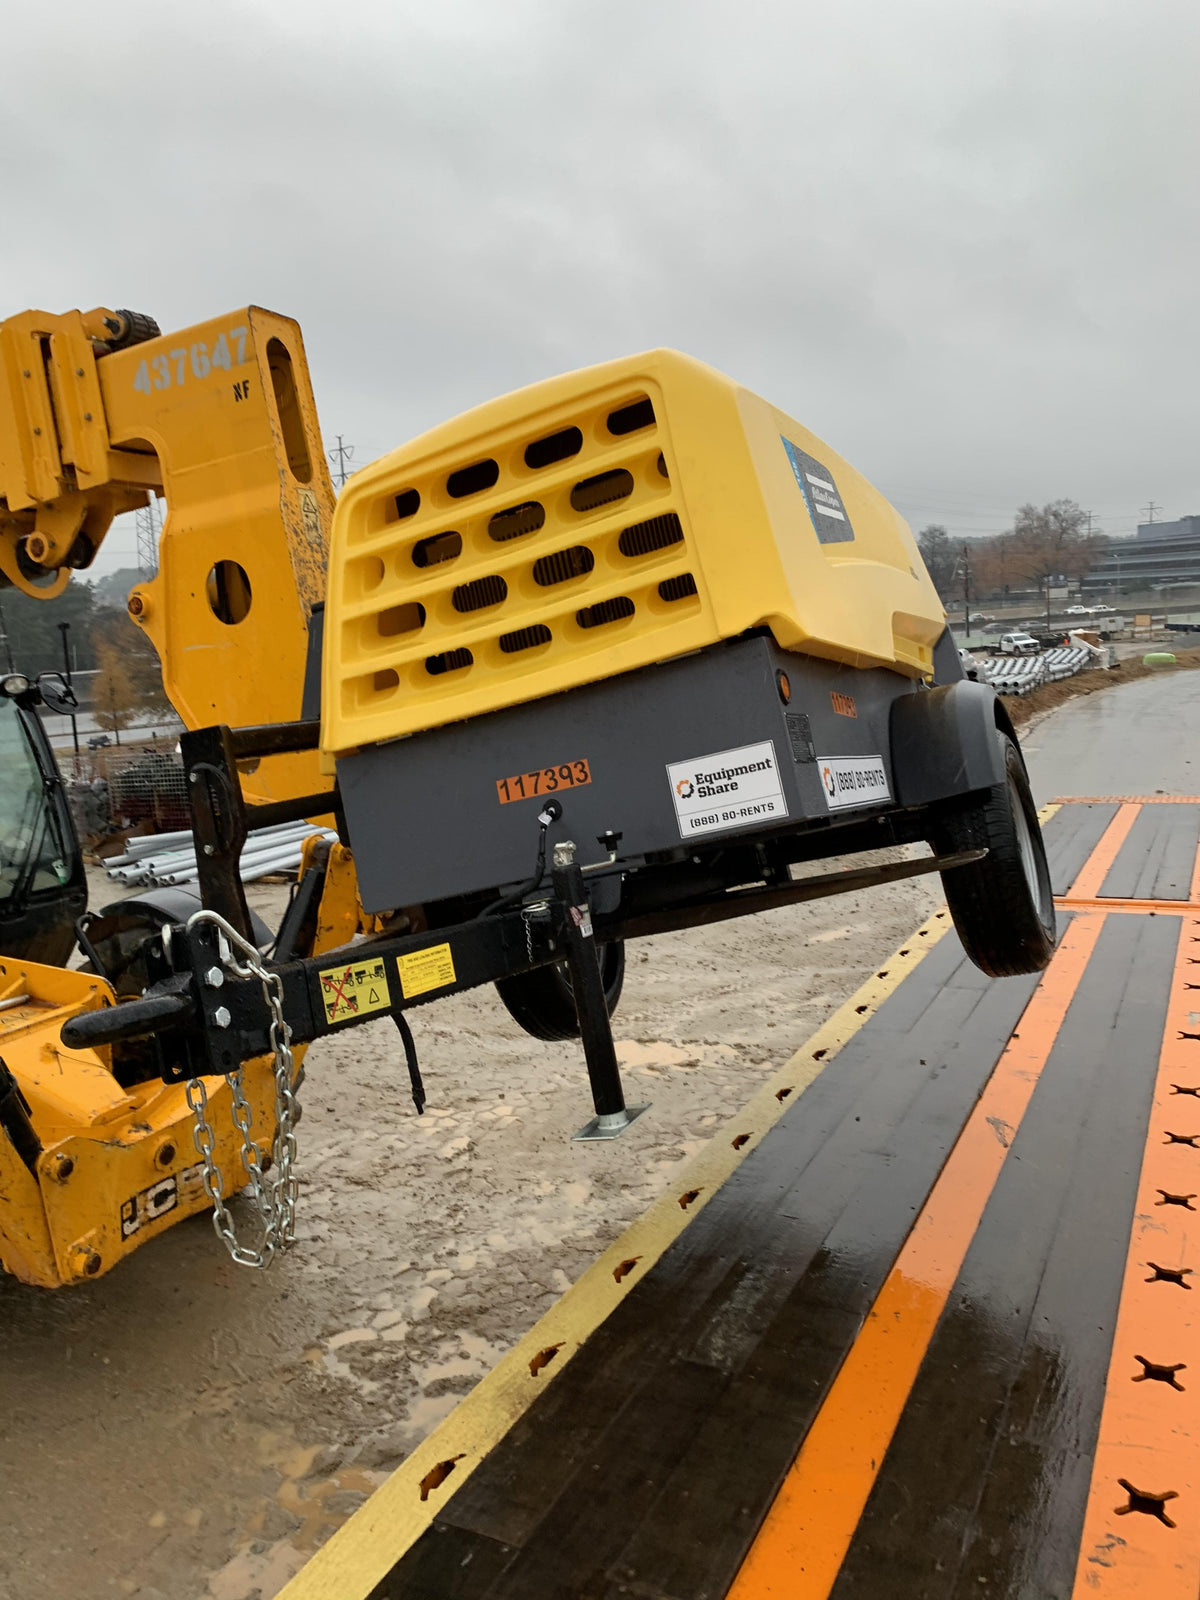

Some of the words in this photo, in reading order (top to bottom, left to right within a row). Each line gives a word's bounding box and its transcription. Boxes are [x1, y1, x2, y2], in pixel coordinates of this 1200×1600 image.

[133, 326, 248, 395] 437647
[232, 379, 250, 402] NF
[500, 761, 589, 801] 117393
[694, 758, 773, 786] Equipment
[835, 769, 857, 792] (888)
[855, 768, 885, 789] 80-RENTS
[697, 781, 738, 798] Share
[690, 813, 719, 828] (888)
[722, 802, 775, 821] 80-RENTS
